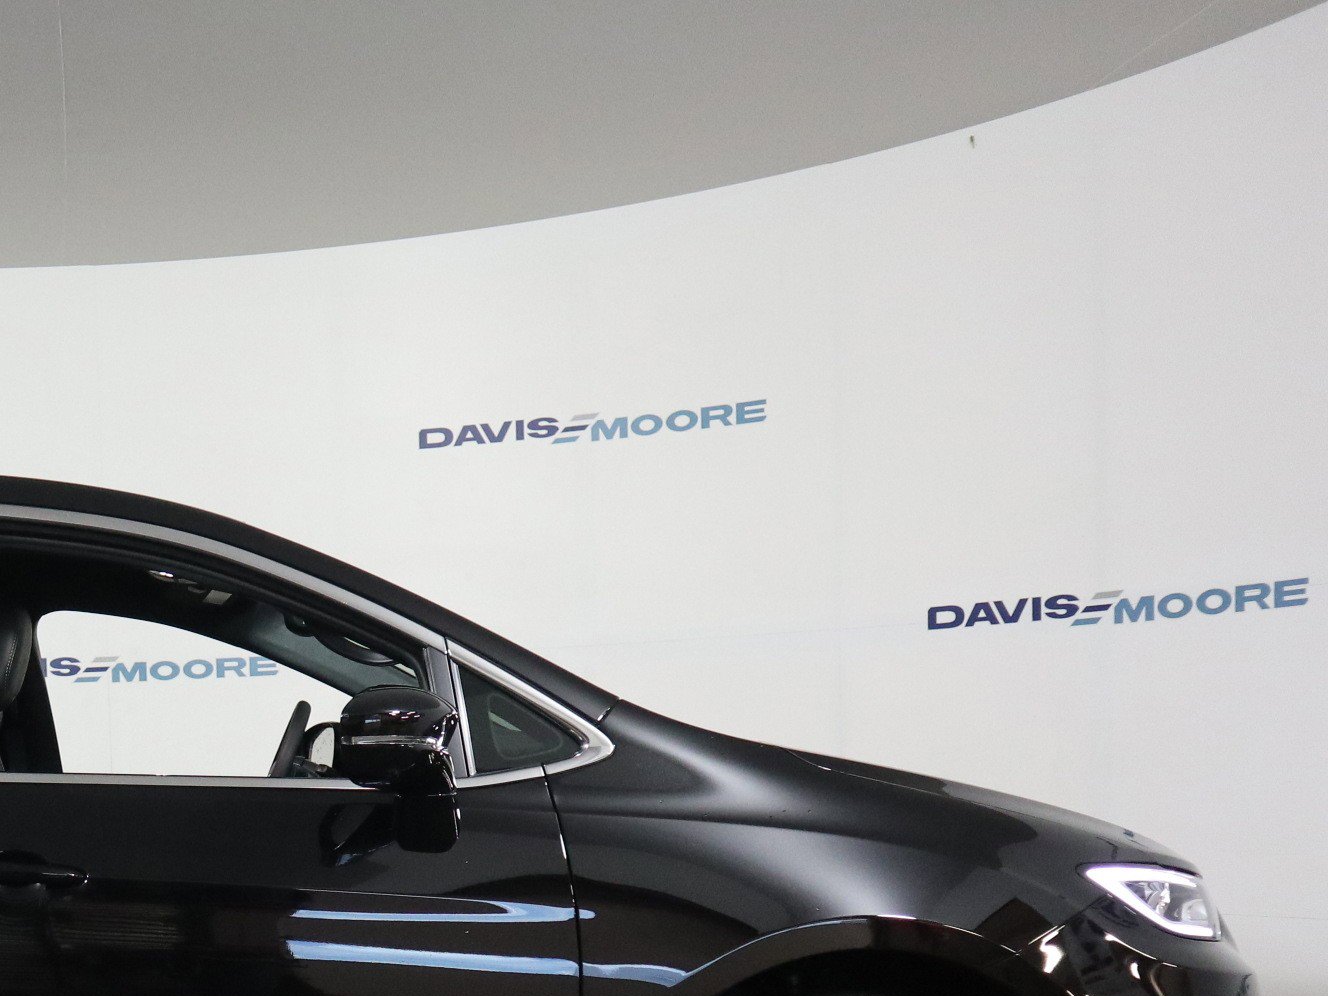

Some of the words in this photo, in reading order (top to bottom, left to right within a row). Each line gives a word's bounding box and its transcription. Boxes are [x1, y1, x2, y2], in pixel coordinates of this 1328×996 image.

[418, 416, 559, 450] DAVIS
[591, 398, 767, 442] MOORE
[927, 593, 1080, 631] DAVIS
[1113, 577, 1310, 624] MOORE
[111, 656, 279, 683] MOORE
